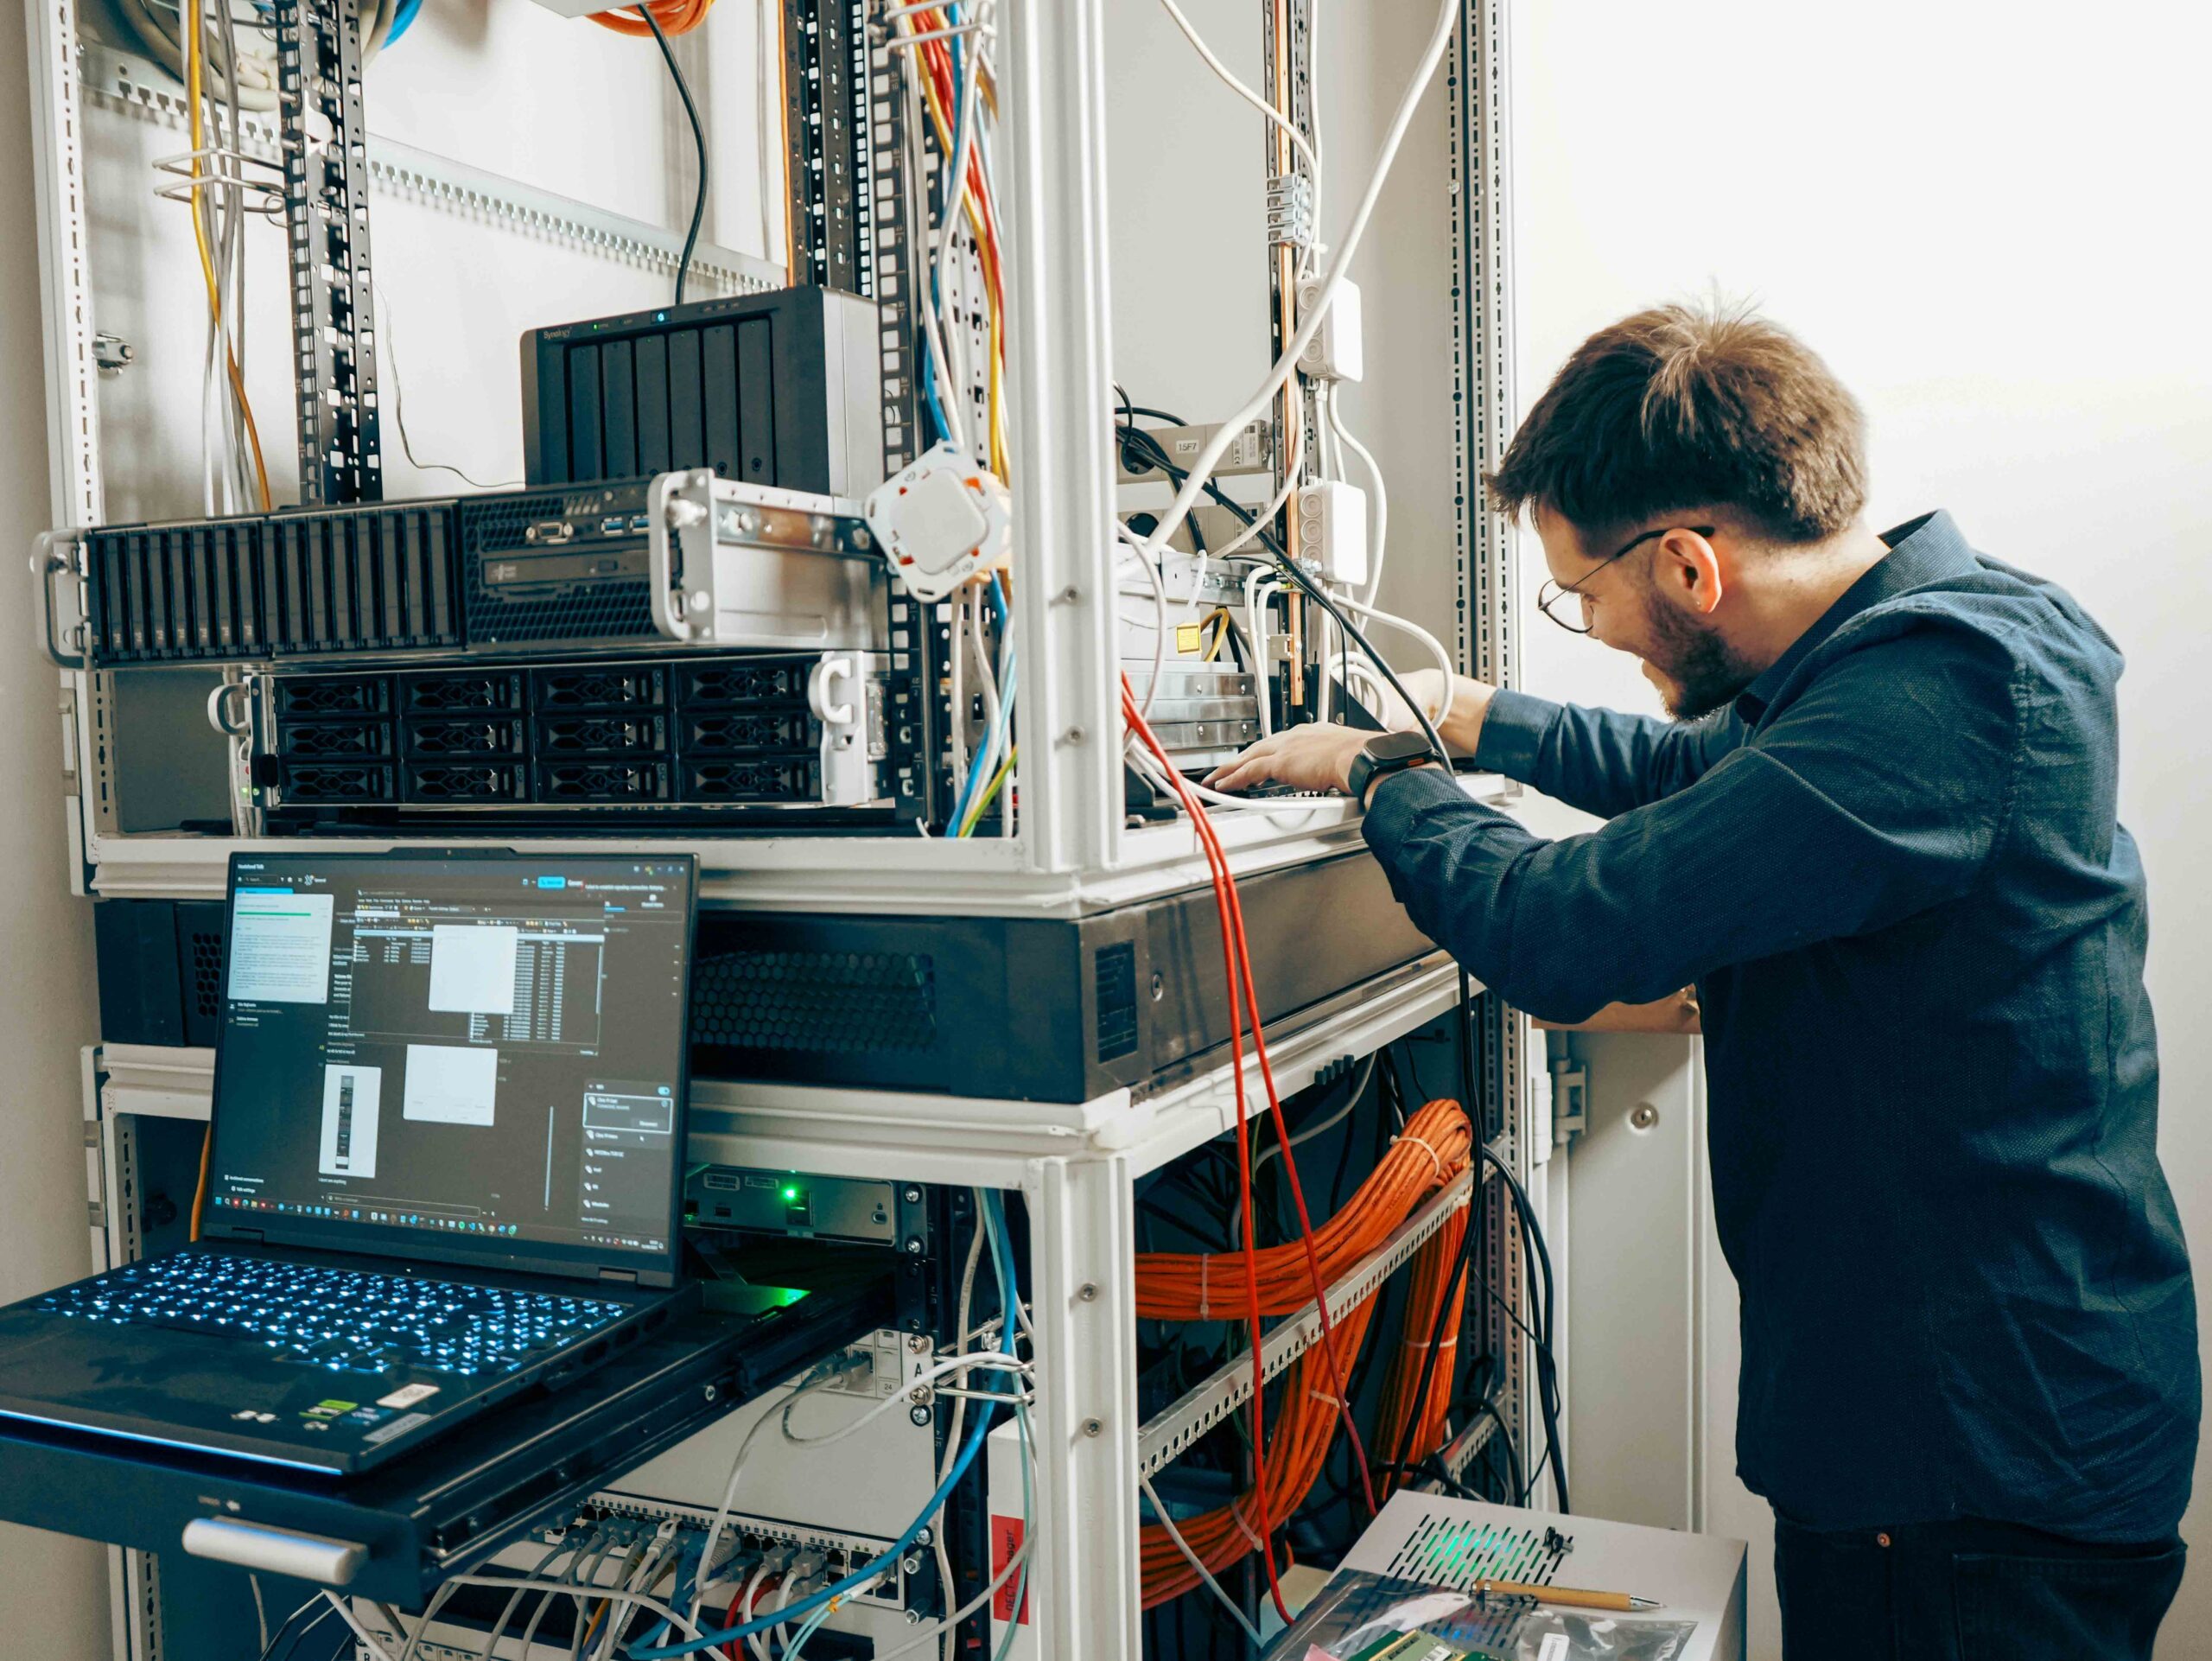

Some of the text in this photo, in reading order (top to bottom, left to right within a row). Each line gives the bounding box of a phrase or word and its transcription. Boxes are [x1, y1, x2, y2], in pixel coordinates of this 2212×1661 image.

[543, 329, 570, 340] Synology
[1179, 442, 1197, 451] 15F7
[914, 1362, 922, 1378] A
[1004, 1529, 1017, 1612] DECT-nager
